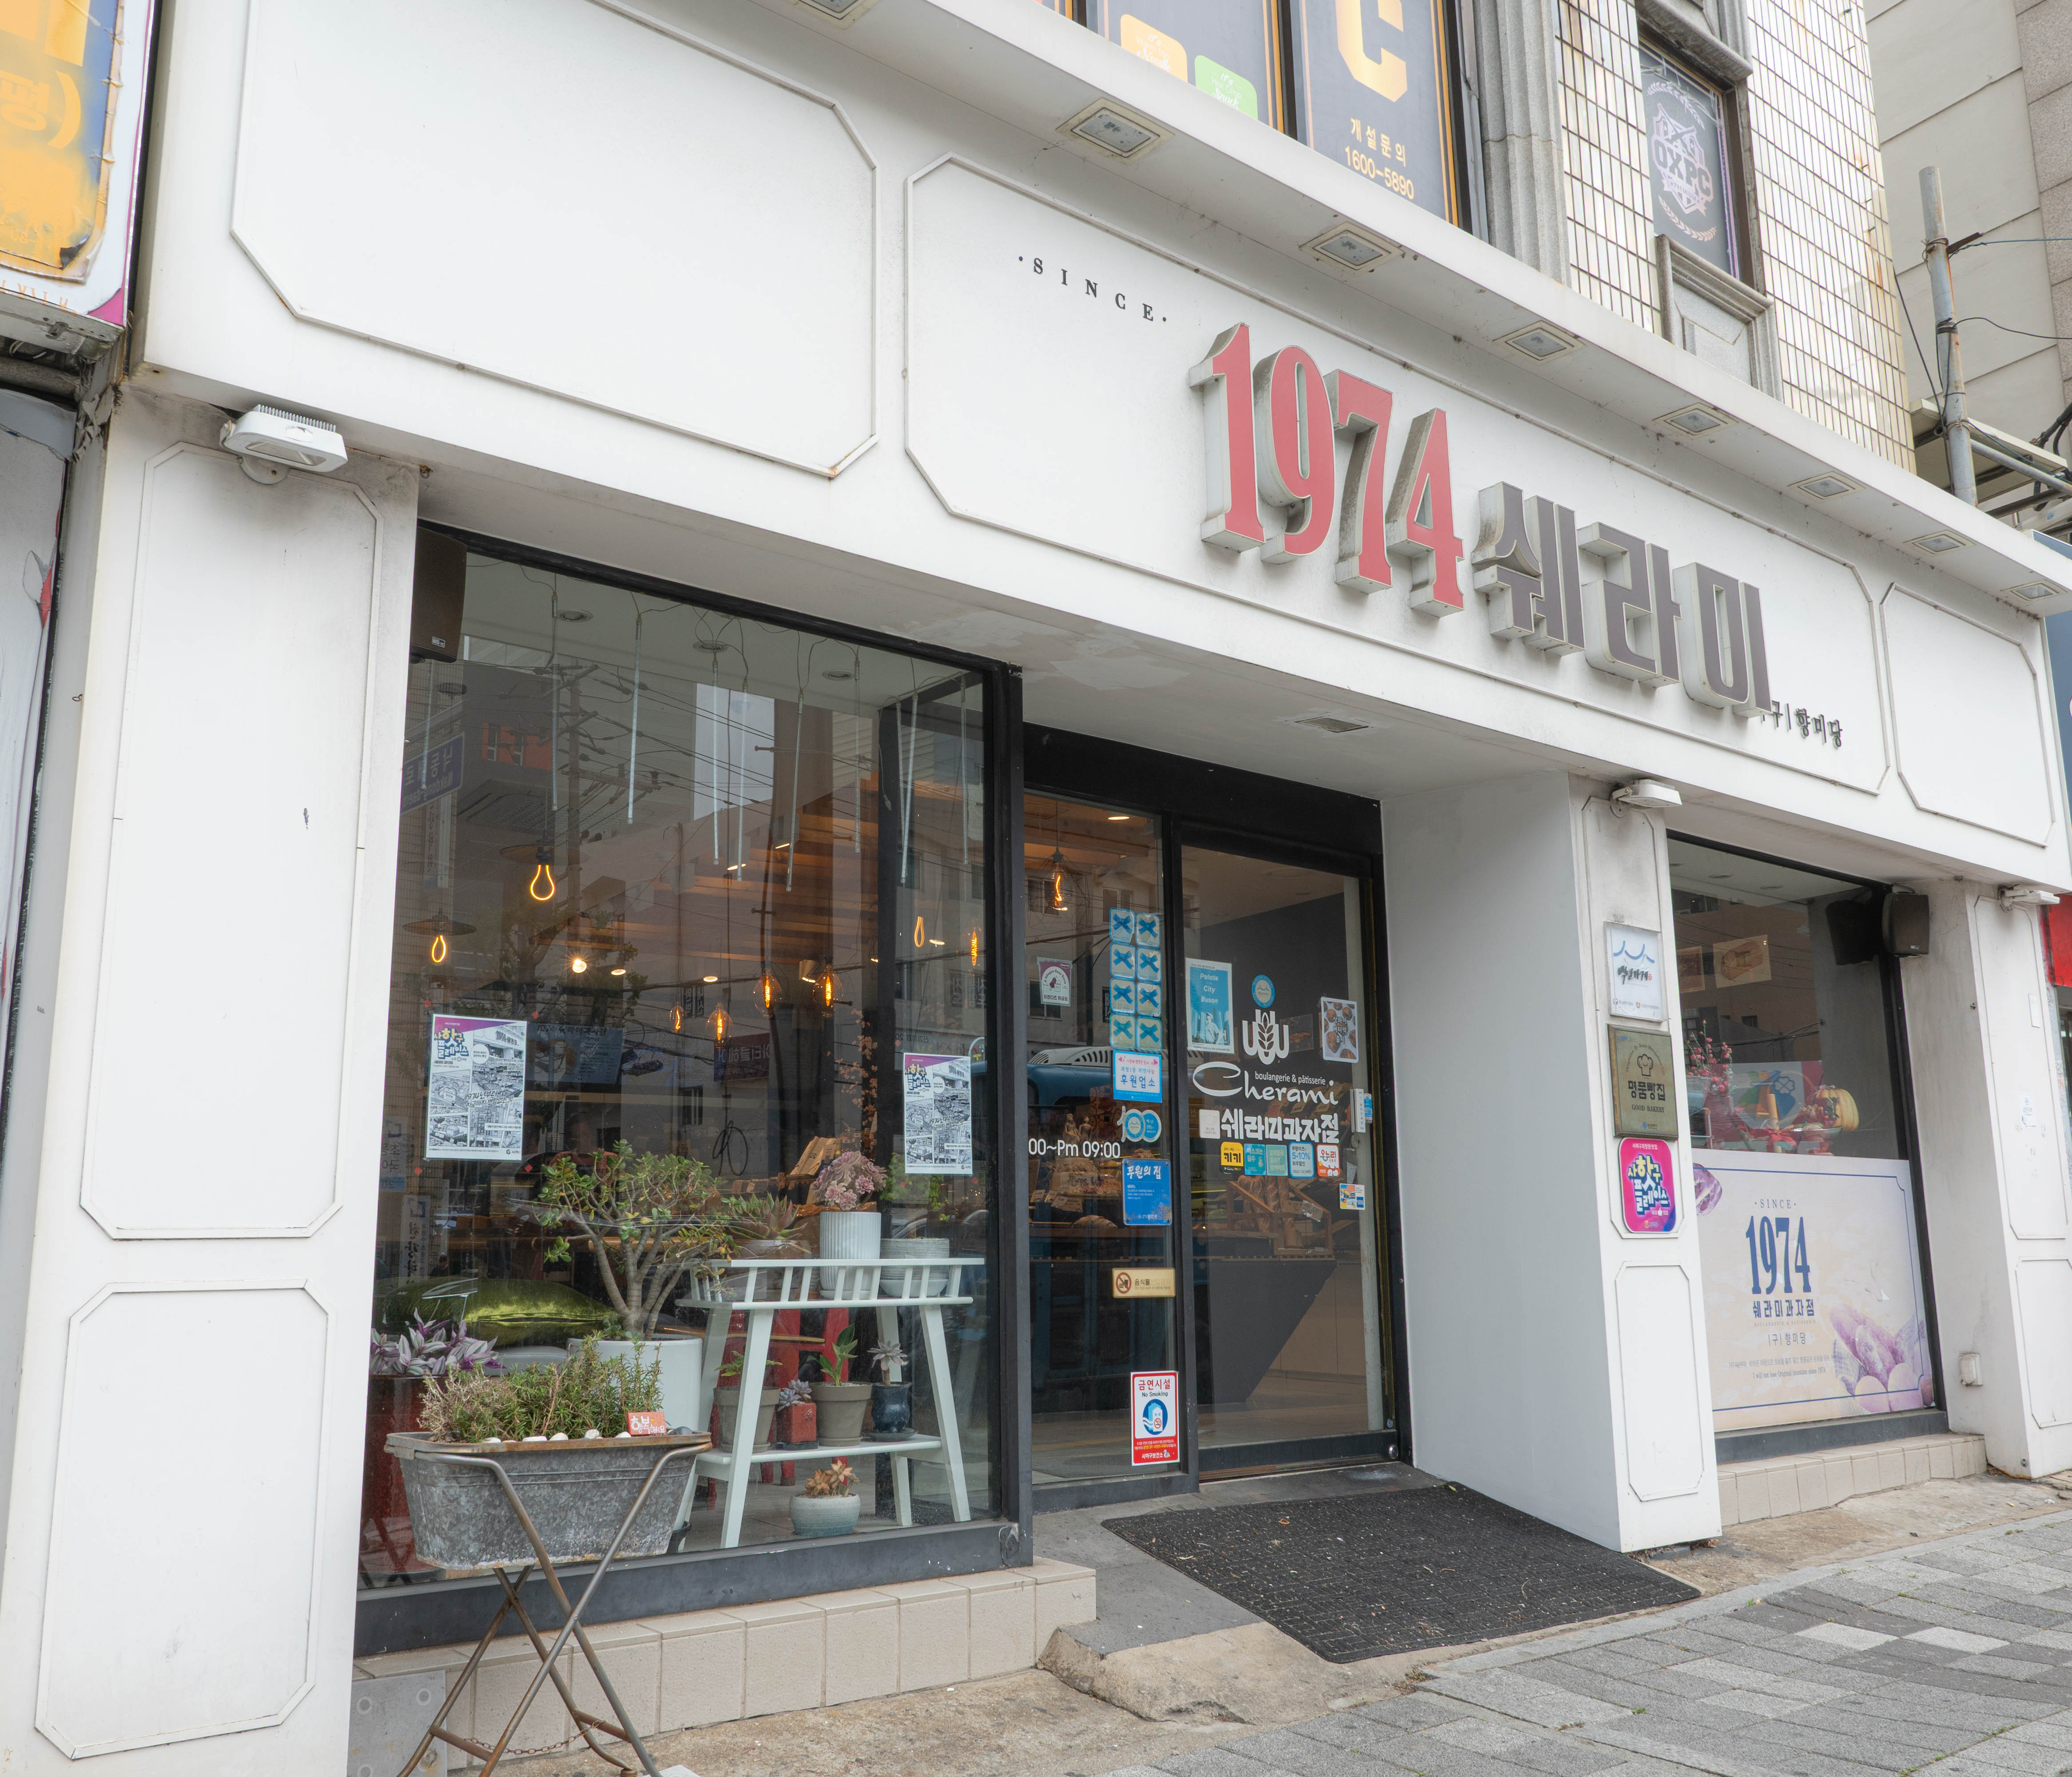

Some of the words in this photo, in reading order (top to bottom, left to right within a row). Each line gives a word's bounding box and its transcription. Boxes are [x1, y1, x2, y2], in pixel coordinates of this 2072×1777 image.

[1344, 146, 1414, 200] 1600-5890
[1189, 323, 1464, 618] 1974
[1472, 482, 1772, 718] 쉐라미
[1203, 985, 1215, 994] City
[1120, 1074, 1155, 1089] 후원업소
[1193, 1061, 1338, 1105] Cherami
[1255, 1071, 1290, 1084] boulangerie
[1292, 1074, 1297, 1083] &
[1298, 1075, 1326, 1085] pâtisserie
[1627, 1080, 1666, 1102] 명품빵집
[1646, 1105, 1665, 1113] BAKERY
[1221, 1108, 1340, 1143] 쉐라미과자점
[1082, 1141, 1121, 1159] 09:00
[1127, 1165, 1151, 1179] 후원의
[1153, 1166, 1161, 1180] 집
[1746, 1215, 1811, 1295] 1974
[1753, 1299, 1814, 1319] 쉐라미과자점
[1785, 1332, 1806, 1346] 향미당
[1137, 1378, 1172, 1391] 금연시설
